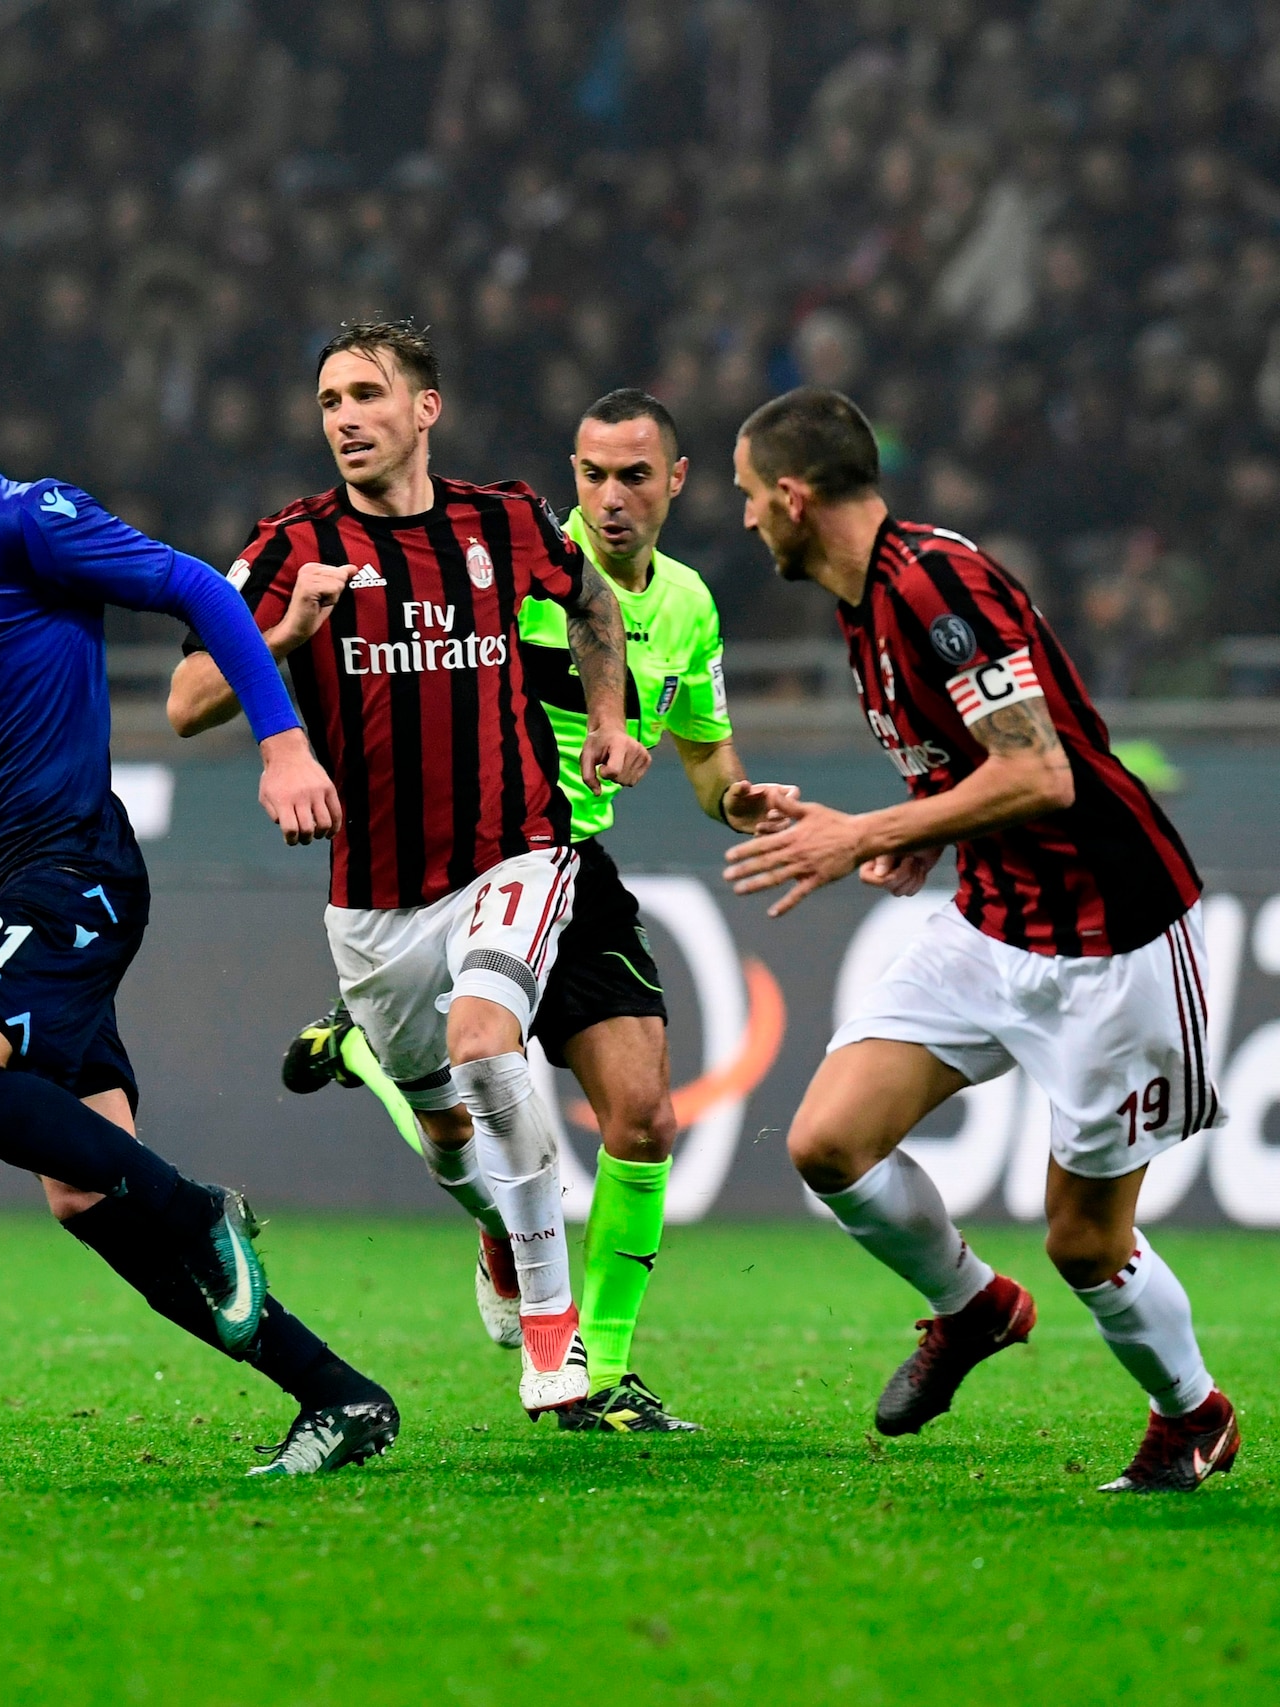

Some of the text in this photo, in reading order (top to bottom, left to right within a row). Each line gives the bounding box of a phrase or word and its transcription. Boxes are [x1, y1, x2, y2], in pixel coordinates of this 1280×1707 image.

[348, 577, 388, 590] adidas
[402, 601, 455, 632] Fly
[340, 629, 507, 675] Emirates
[975, 663, 1014, 701] C
[1116, 1076, 1170, 1147] 19
